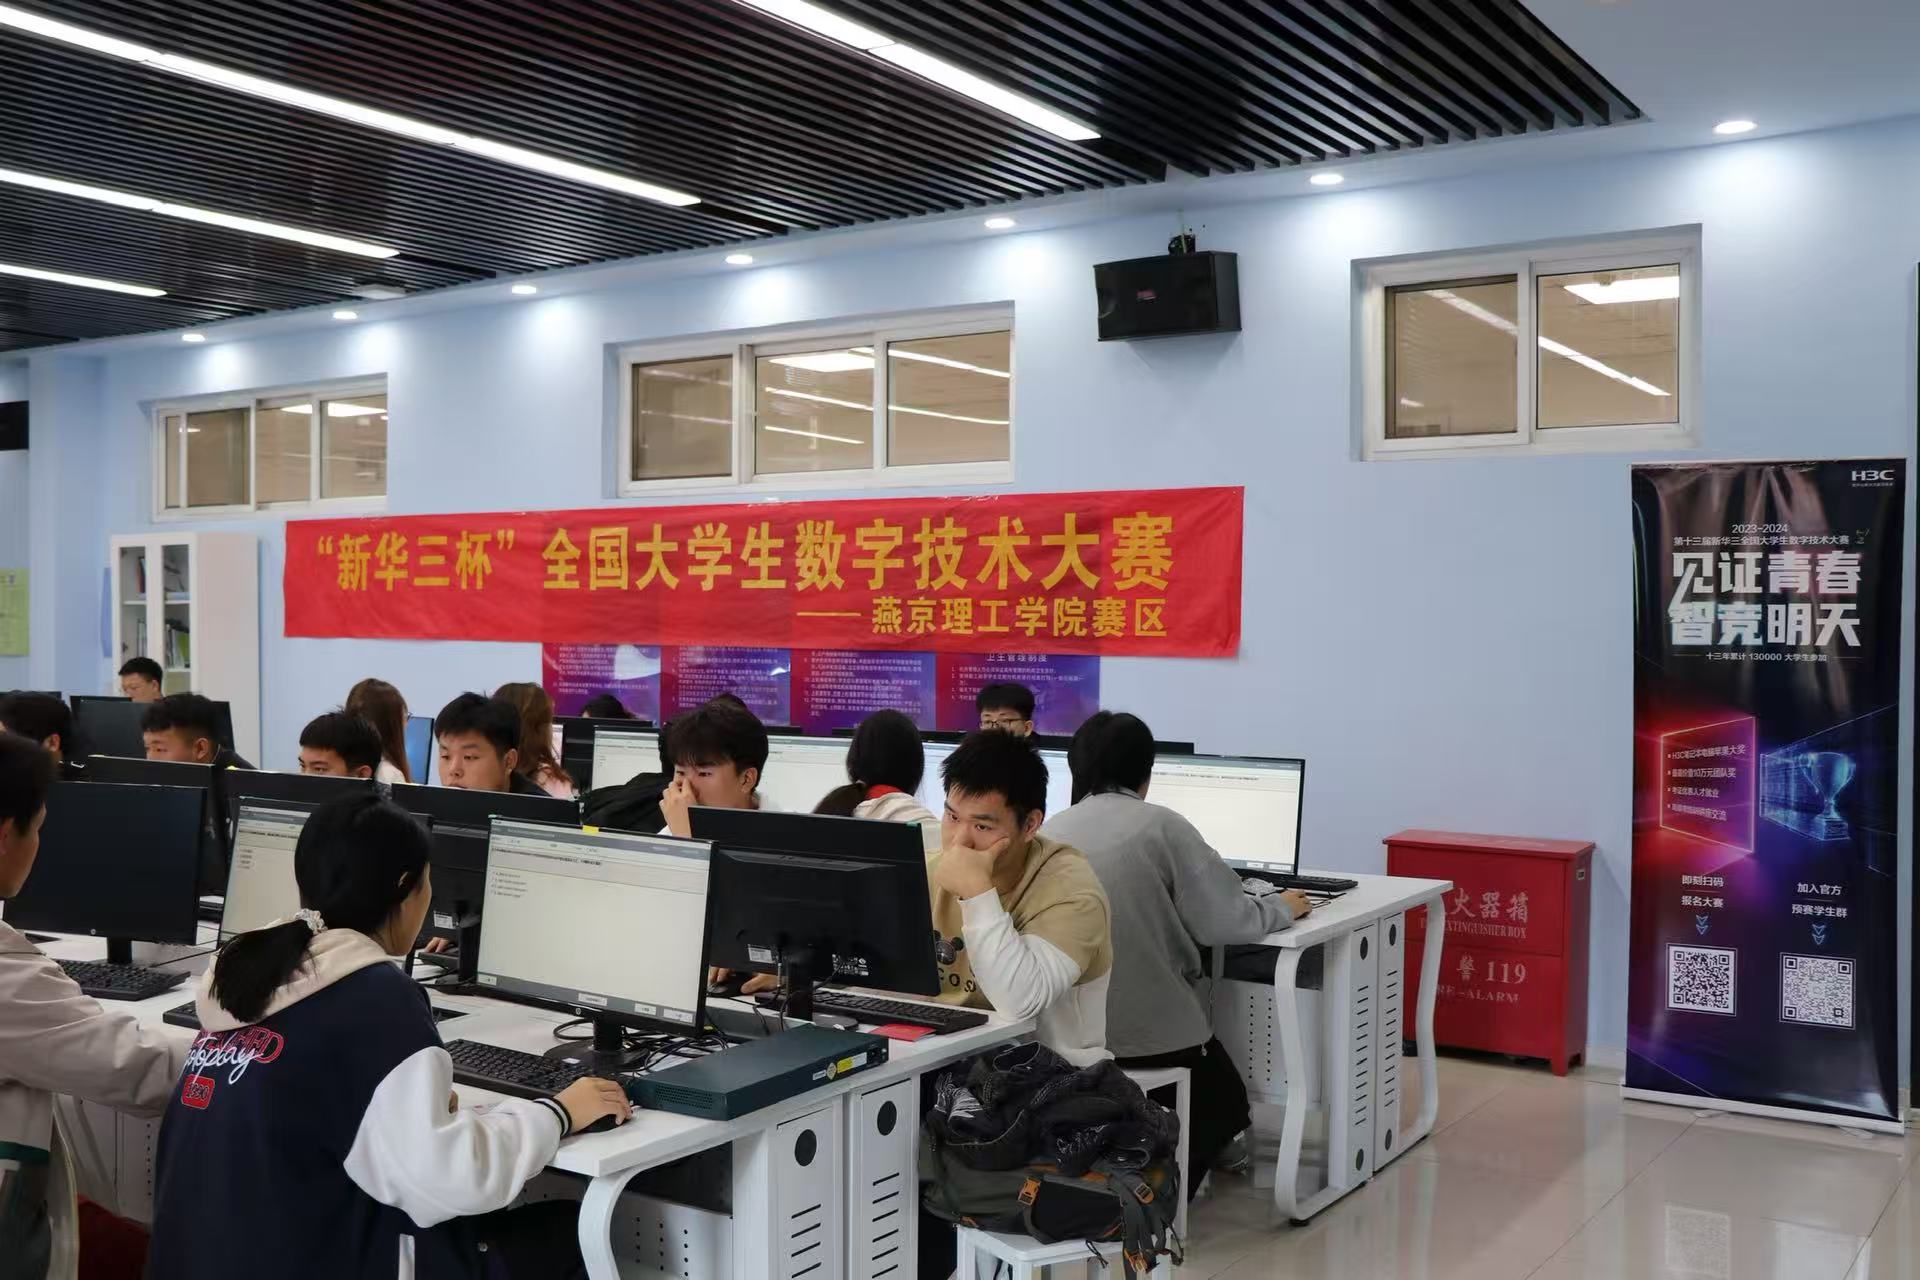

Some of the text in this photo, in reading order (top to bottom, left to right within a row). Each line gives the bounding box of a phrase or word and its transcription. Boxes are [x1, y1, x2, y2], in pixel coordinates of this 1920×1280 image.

[1851, 469, 1895, 481] H3C
[1731, 523, 1789, 534] 2023-2024
[1673, 535, 1850, 546] 第十三届新华三全国大学生数字技术大赛
[317, 511, 1174, 593] “新华三杯” 全国大学生数字技术大赛
[1670, 550, 1861, 594] 见证青春
[1668, 600, 1861, 647] 智竞明天
[1748, 652, 1783, 661] 130000
[1681, 875, 1725, 888] 即刻扫码
[1796, 882, 1843, 896] 加入官方
[1681, 895, 1725, 909] 报名大赛
[1791, 903, 1848, 918] 预赛学生群
[1446, 919, 1507, 937] XTINGUISHER
[1485, 961, 1527, 985] 119
